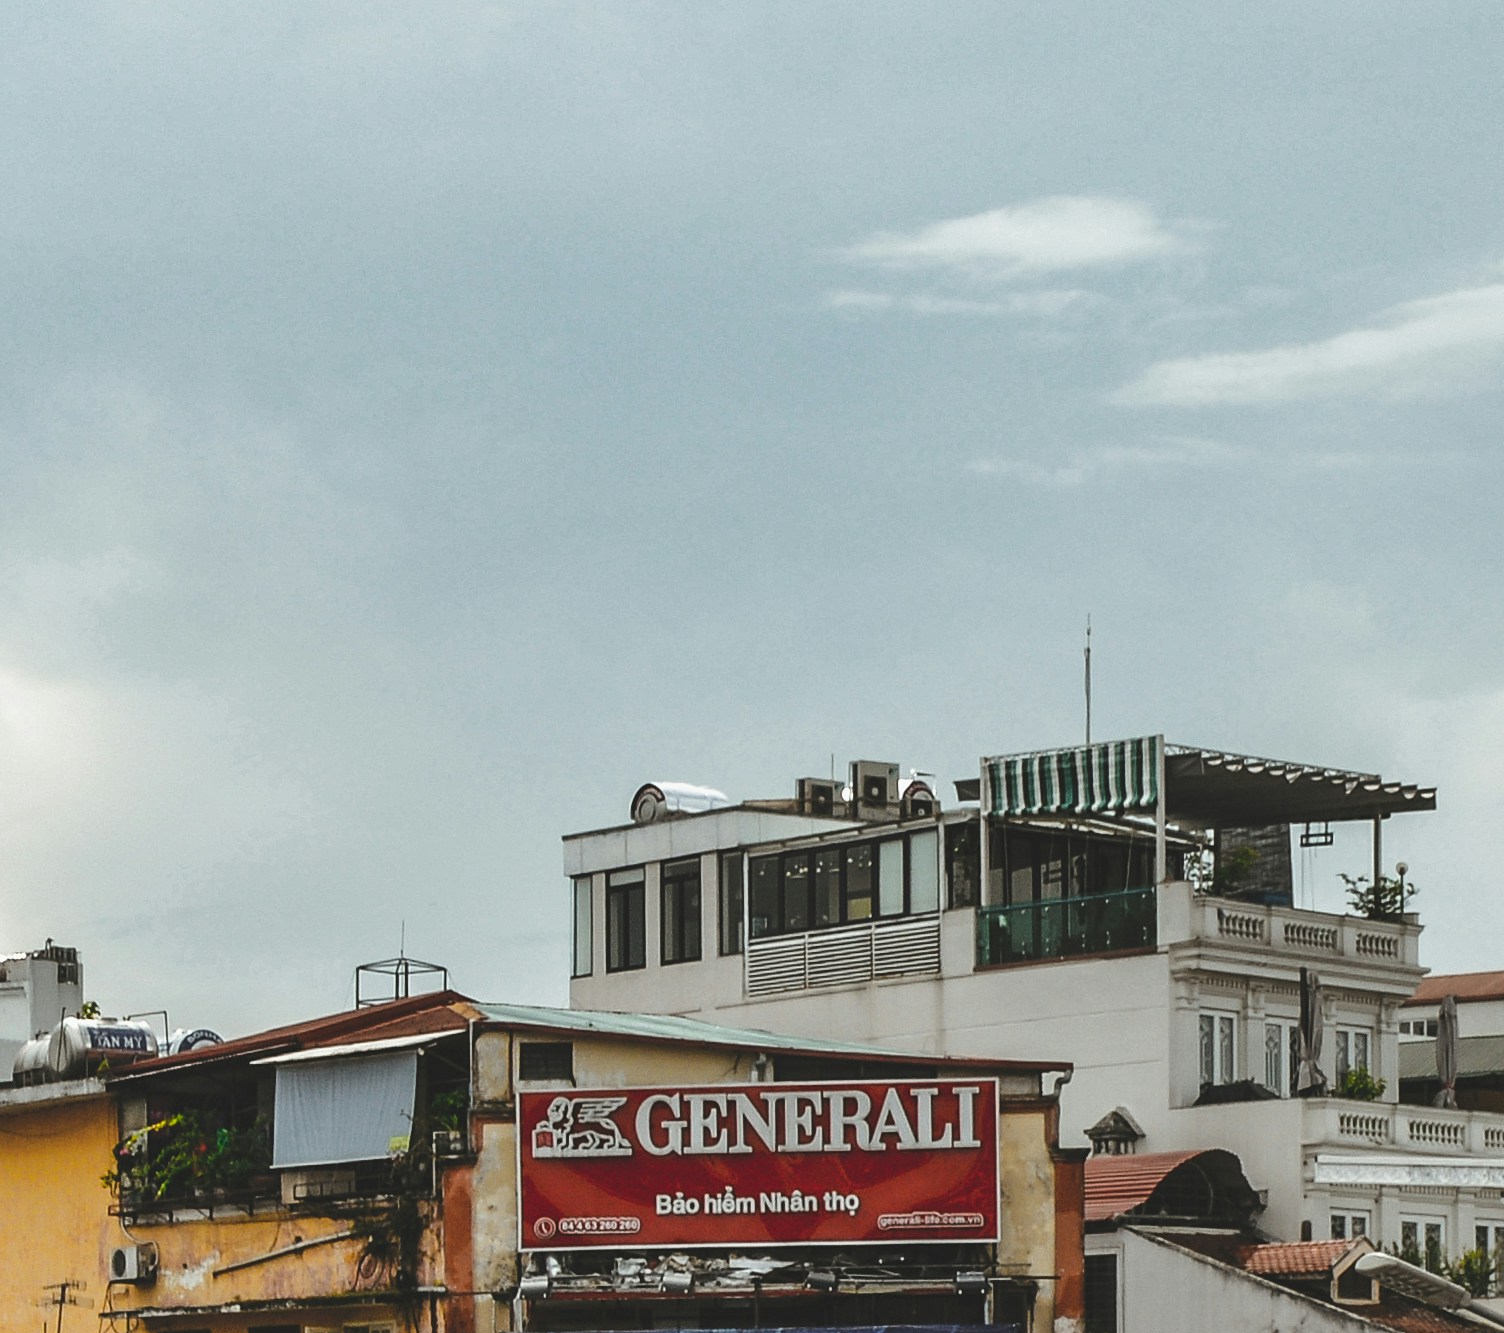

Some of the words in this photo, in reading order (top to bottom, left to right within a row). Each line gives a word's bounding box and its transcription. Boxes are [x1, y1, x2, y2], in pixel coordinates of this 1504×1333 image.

[634, 1086, 982, 1157] GENERALI
[654, 1192, 699, 1216] Bảo
[703, 1186, 756, 1214] hiểm
[759, 1191, 819, 1213] Nhân
[823, 1191, 860, 1217] thọ
